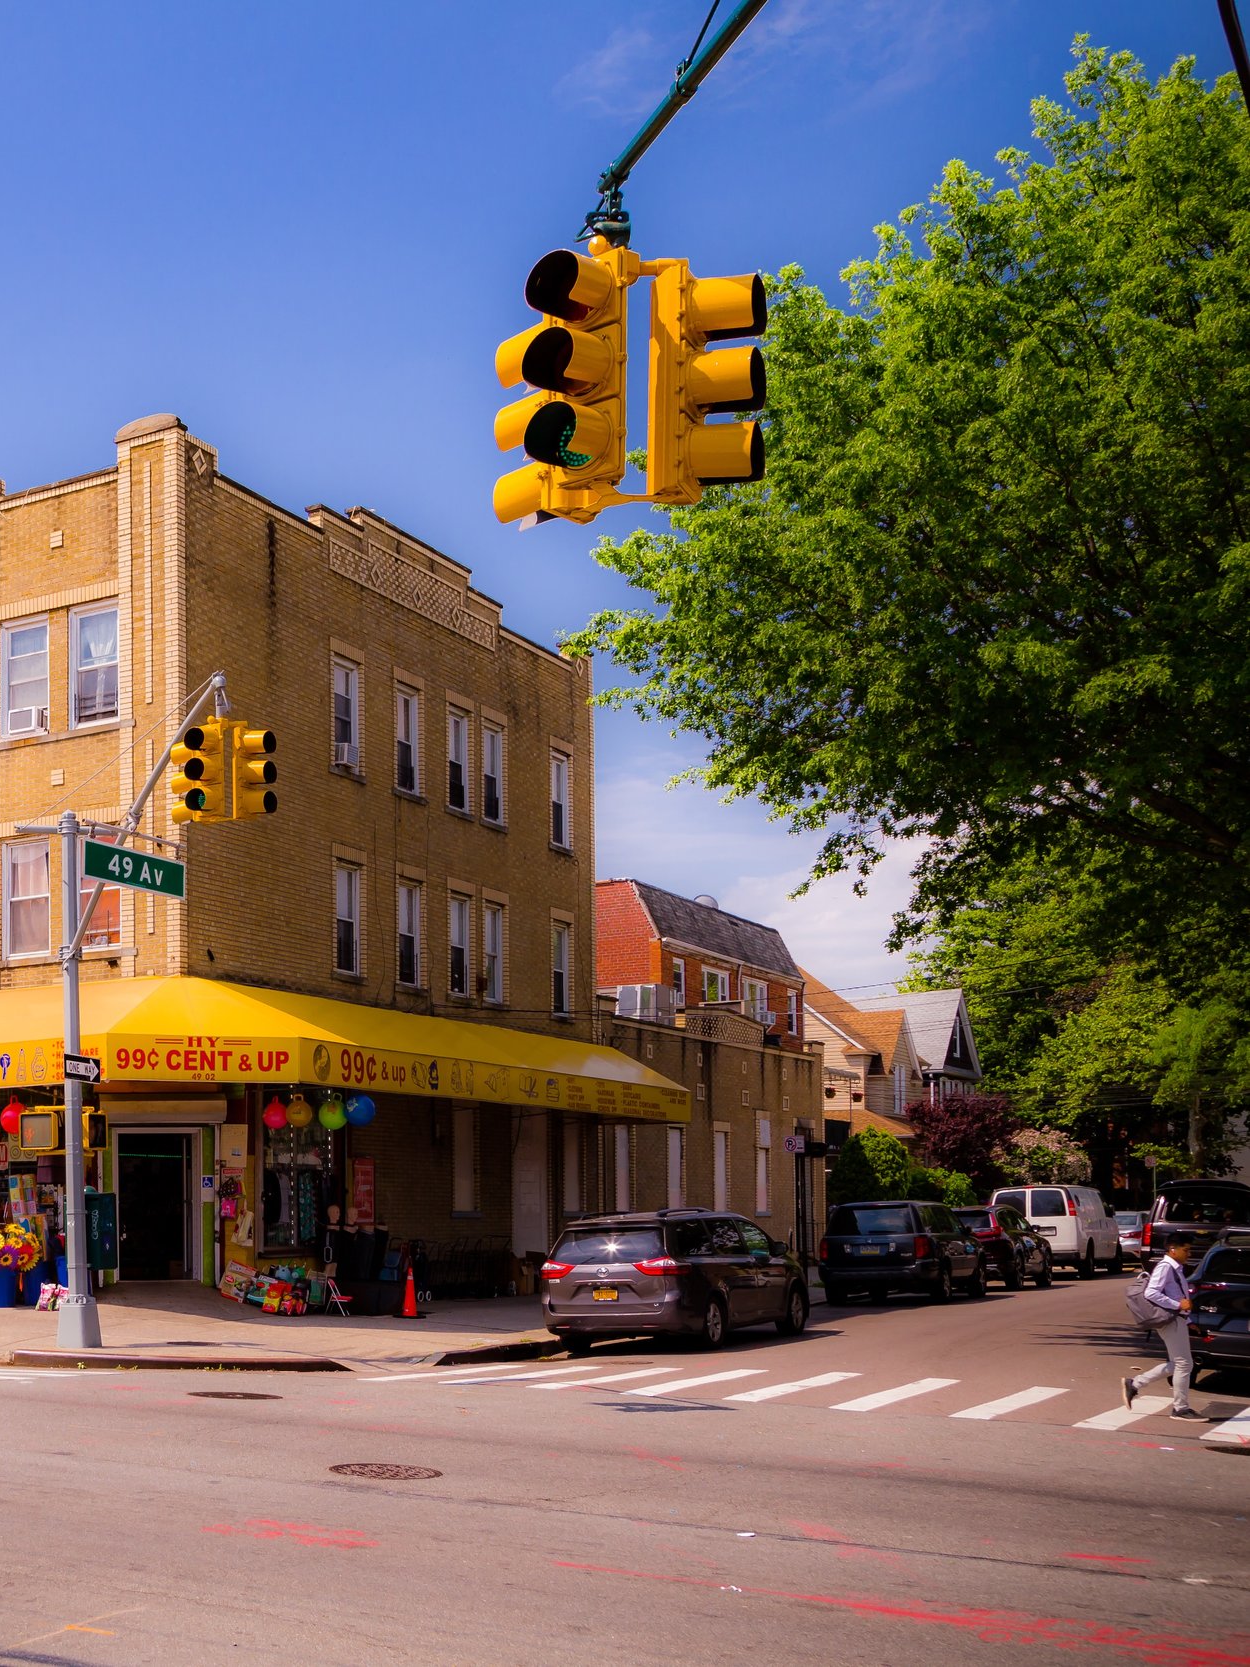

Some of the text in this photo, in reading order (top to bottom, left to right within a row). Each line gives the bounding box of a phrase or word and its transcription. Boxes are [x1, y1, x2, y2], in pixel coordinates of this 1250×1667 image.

[108, 854, 163, 886] 49 Av
[187, 1036, 220, 1048] HY
[68, 1062, 80, 1073] ONE
[84, 1064, 95, 1075] WAY
[116, 1048, 159, 1070] 99¢
[165, 1049, 233, 1072] CENT
[238, 1054, 253, 1072] &
[257, 1050, 290, 1072] UP
[340, 1049, 406, 1088] 99¢ & up
[191, 1073, 216, 1081] 49 02
